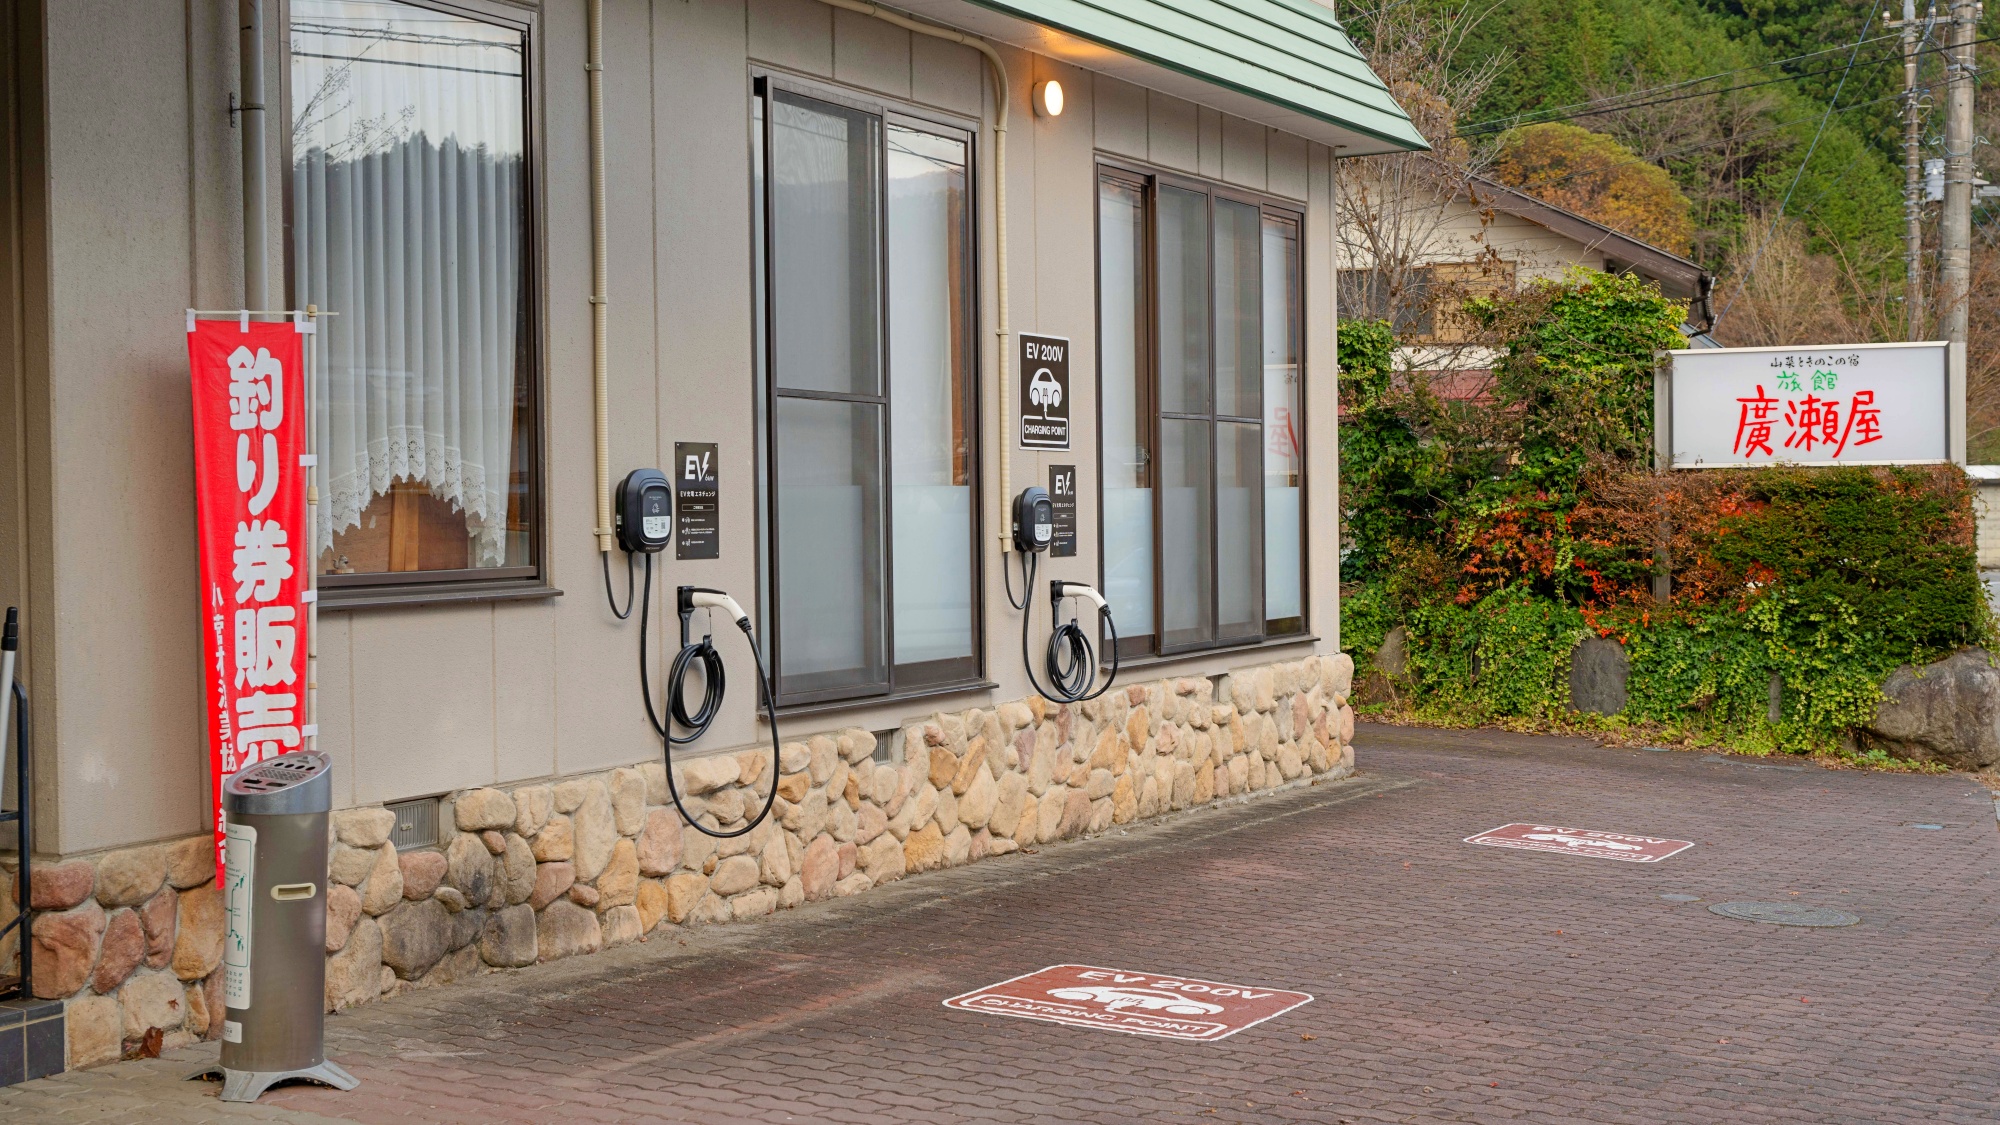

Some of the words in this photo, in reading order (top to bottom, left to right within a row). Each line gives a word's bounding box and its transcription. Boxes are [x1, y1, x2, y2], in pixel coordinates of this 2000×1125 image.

[1026, 342, 1039, 360] EV
[1041, 345, 1064, 363] 200V
[1770, 354, 1860, 368] 山菜ときのこの宿
[1776, 370, 1839, 392] 旅館
[1024, 424, 1051, 435] CHARGING
[1051, 426, 1067, 436] POINT
[1733, 384, 1883, 459] 廣瀬屋
[684, 451, 711, 482] EV
[1055, 471, 1072, 496] EV
[227, 346, 301, 770] 釣り券販売
[1532, 826, 1578, 834] EV
[1584, 832, 1667, 844] 200V
[1077, 970, 1146, 983] EV
[1150, 980, 1274, 999] 200V
[981, 999, 1117, 1021] CHARGING
[1122, 1017, 1208, 1032] POINT
